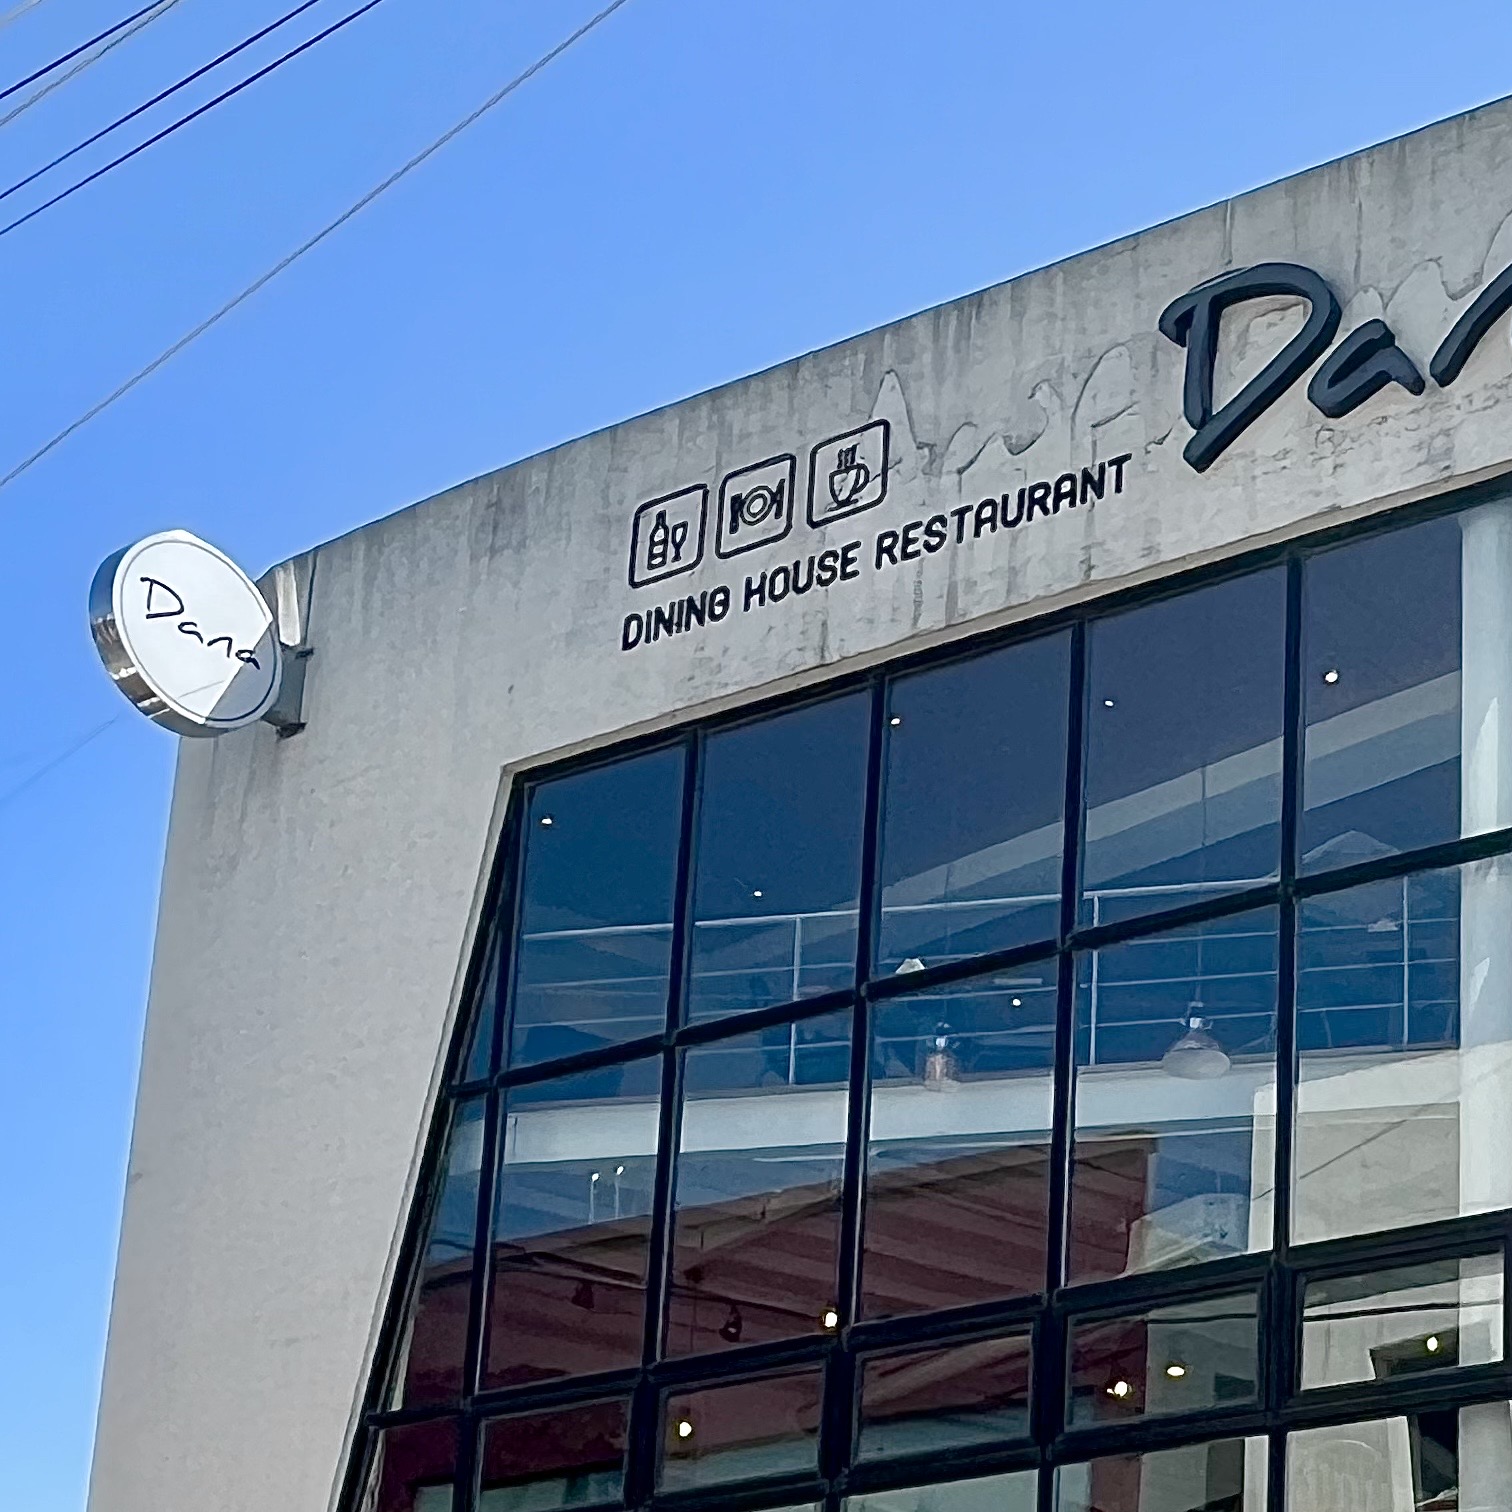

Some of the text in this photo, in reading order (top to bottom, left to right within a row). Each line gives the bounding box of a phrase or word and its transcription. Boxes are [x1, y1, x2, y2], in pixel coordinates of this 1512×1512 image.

[140, 576, 261, 670] Dana
[621, 453, 1133, 652] DINING HOUSE RESTAURANT
